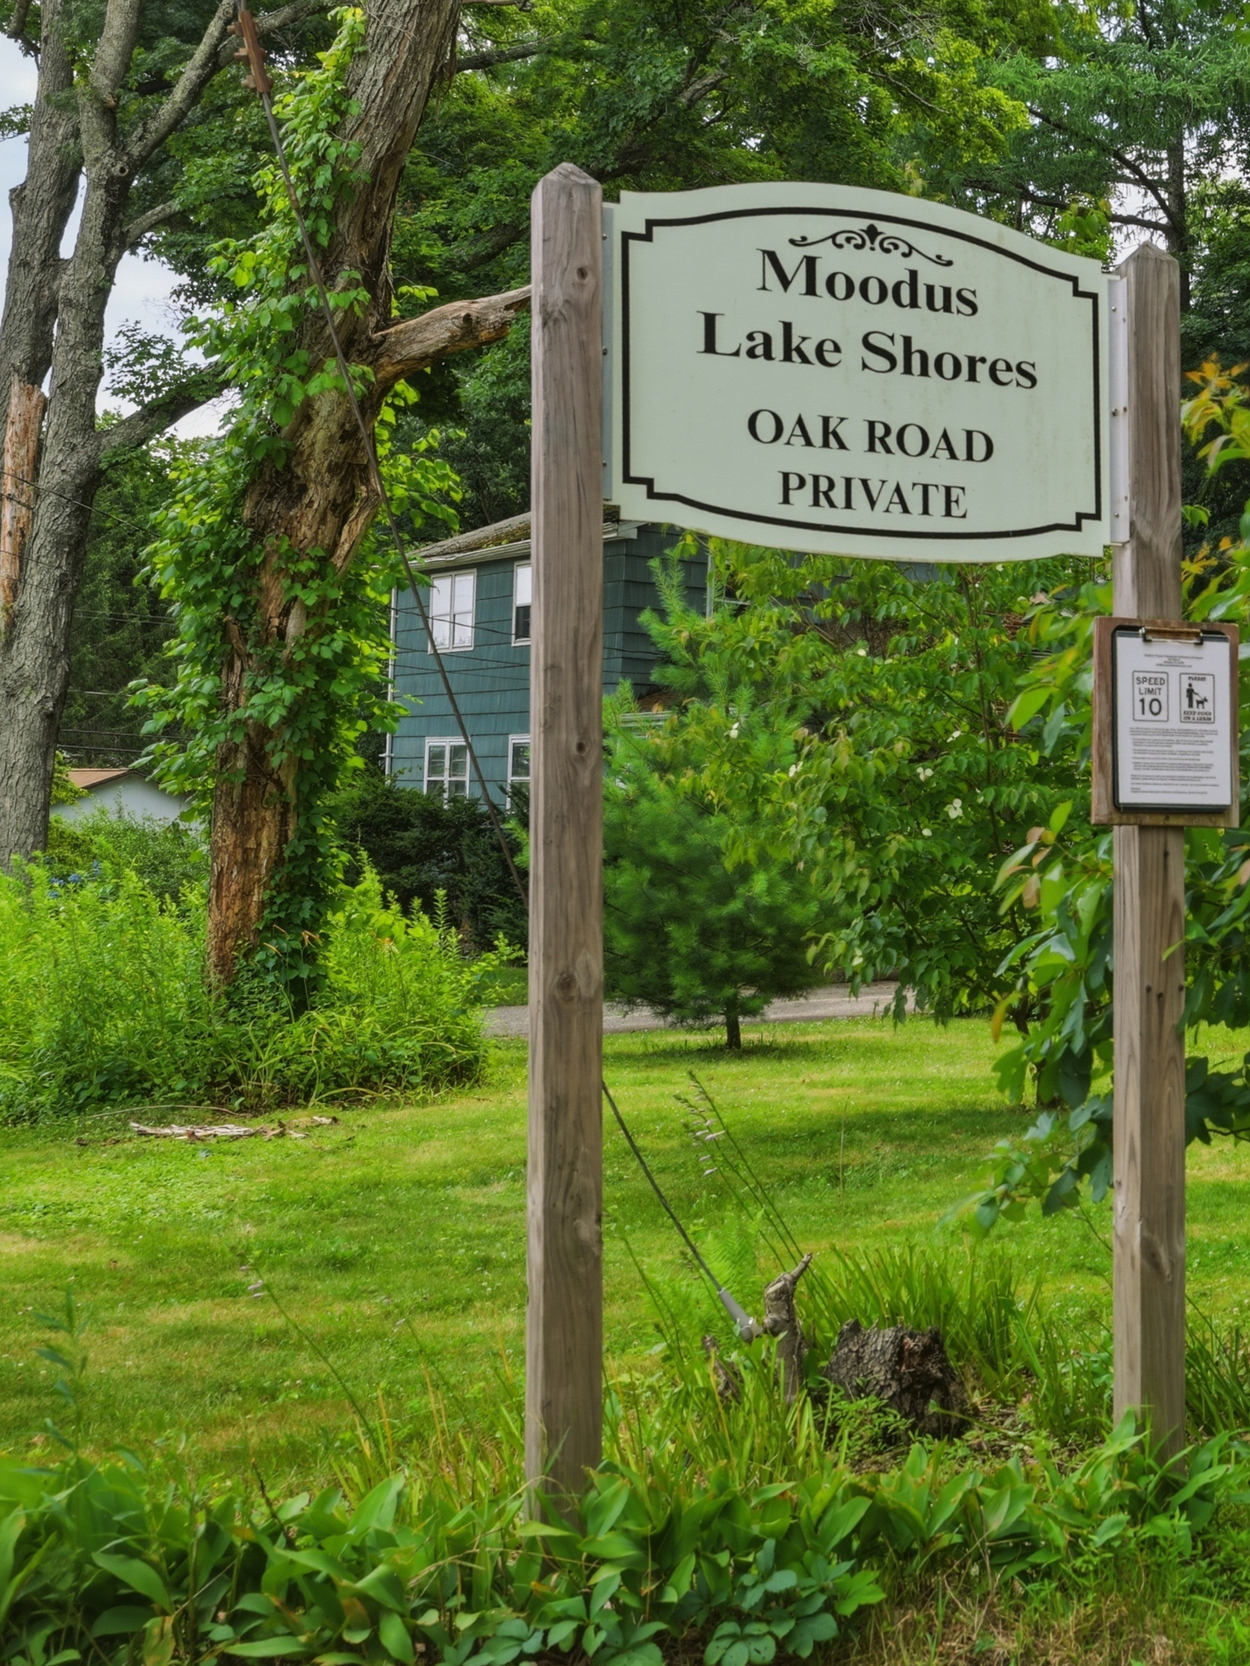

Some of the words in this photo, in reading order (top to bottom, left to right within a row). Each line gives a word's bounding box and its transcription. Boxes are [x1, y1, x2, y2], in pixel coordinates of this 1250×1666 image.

[756, 248, 979, 317] Moodus
[696, 310, 842, 368] Lake
[861, 330, 1038, 390] Shores
[747, 408, 850, 452] OAK
[863, 418, 994, 464] ROAD
[778, 470, 968, 519] PRIVATE
[1136, 676, 1166, 686] SPEED
[1138, 687, 1162, 696] LIMIT
[1139, 697, 1162, 716] 10
